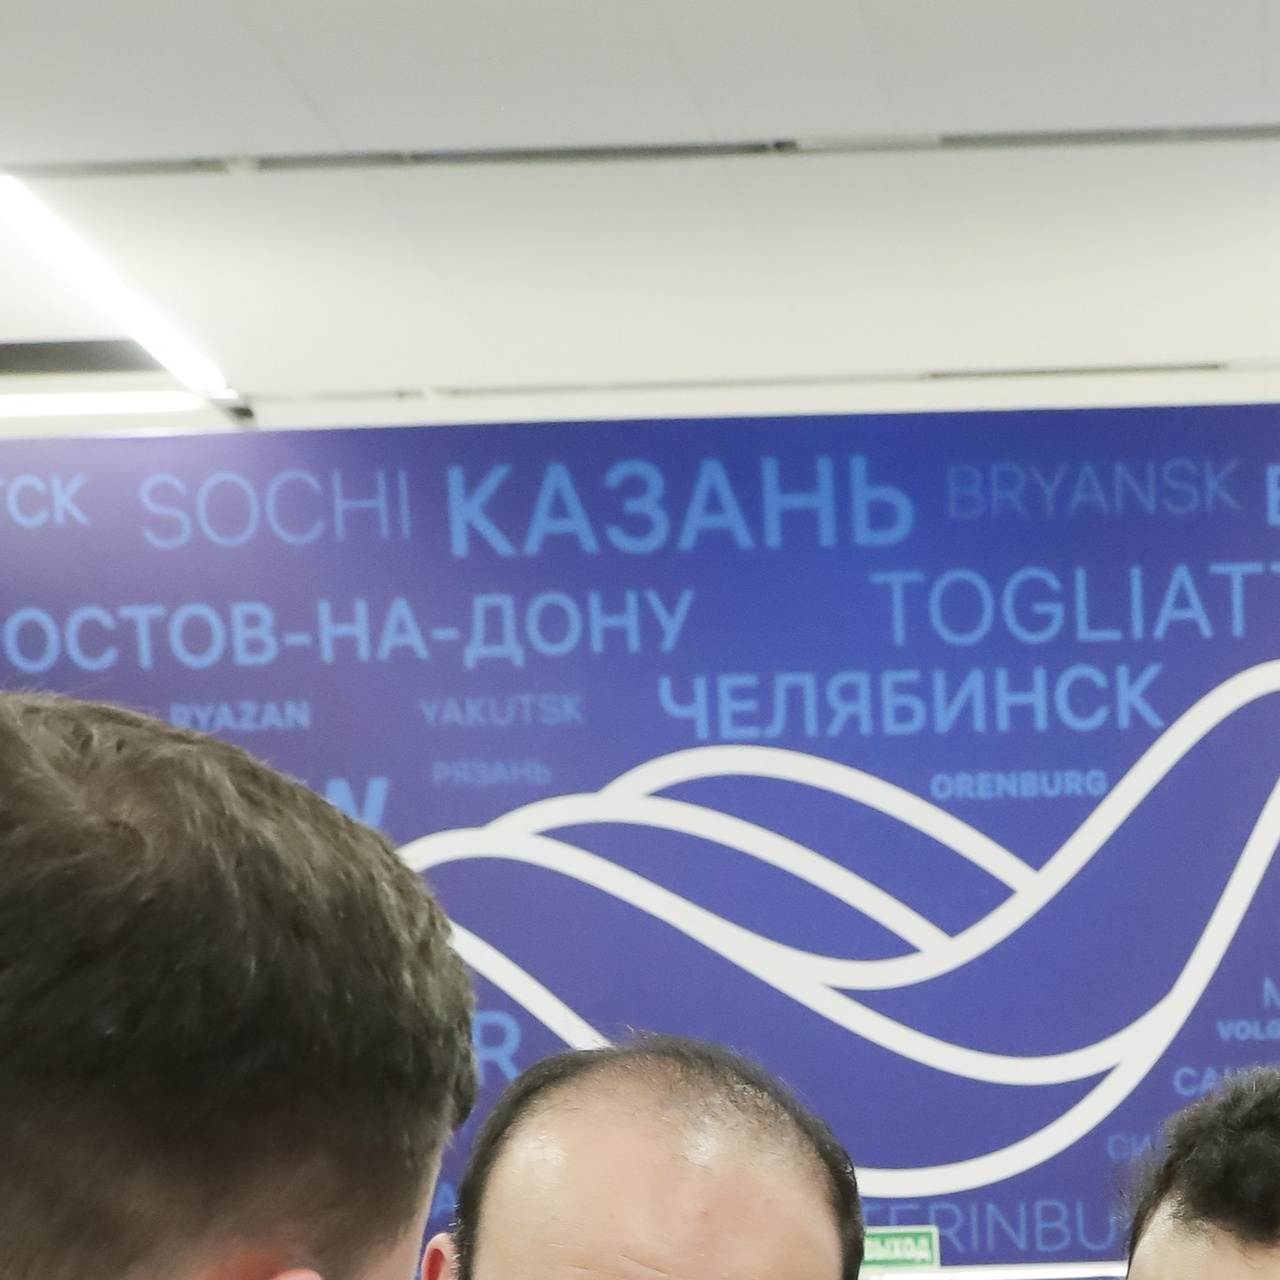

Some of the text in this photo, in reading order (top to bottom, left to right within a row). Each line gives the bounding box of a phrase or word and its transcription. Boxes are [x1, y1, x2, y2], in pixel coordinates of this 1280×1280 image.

[0, 473, 90, 528] СК
[140, 468, 411, 549] SOCHI
[446, 455, 915, 558] КАЗАНЬ
[946, 458, 1243, 521] BRYANSK
[0, 588, 694, 674] ОСТОВ-НА-ДОНУ
[168, 700, 311, 732] RYAZAN
[420, 692, 586, 728] YAKUTSK
[659, 661, 1165, 741] ЧЕЛЯБИНСК
[431, 759, 552, 788] РЯЗАНЬ
[929, 768, 1109, 801] ORENBURG
